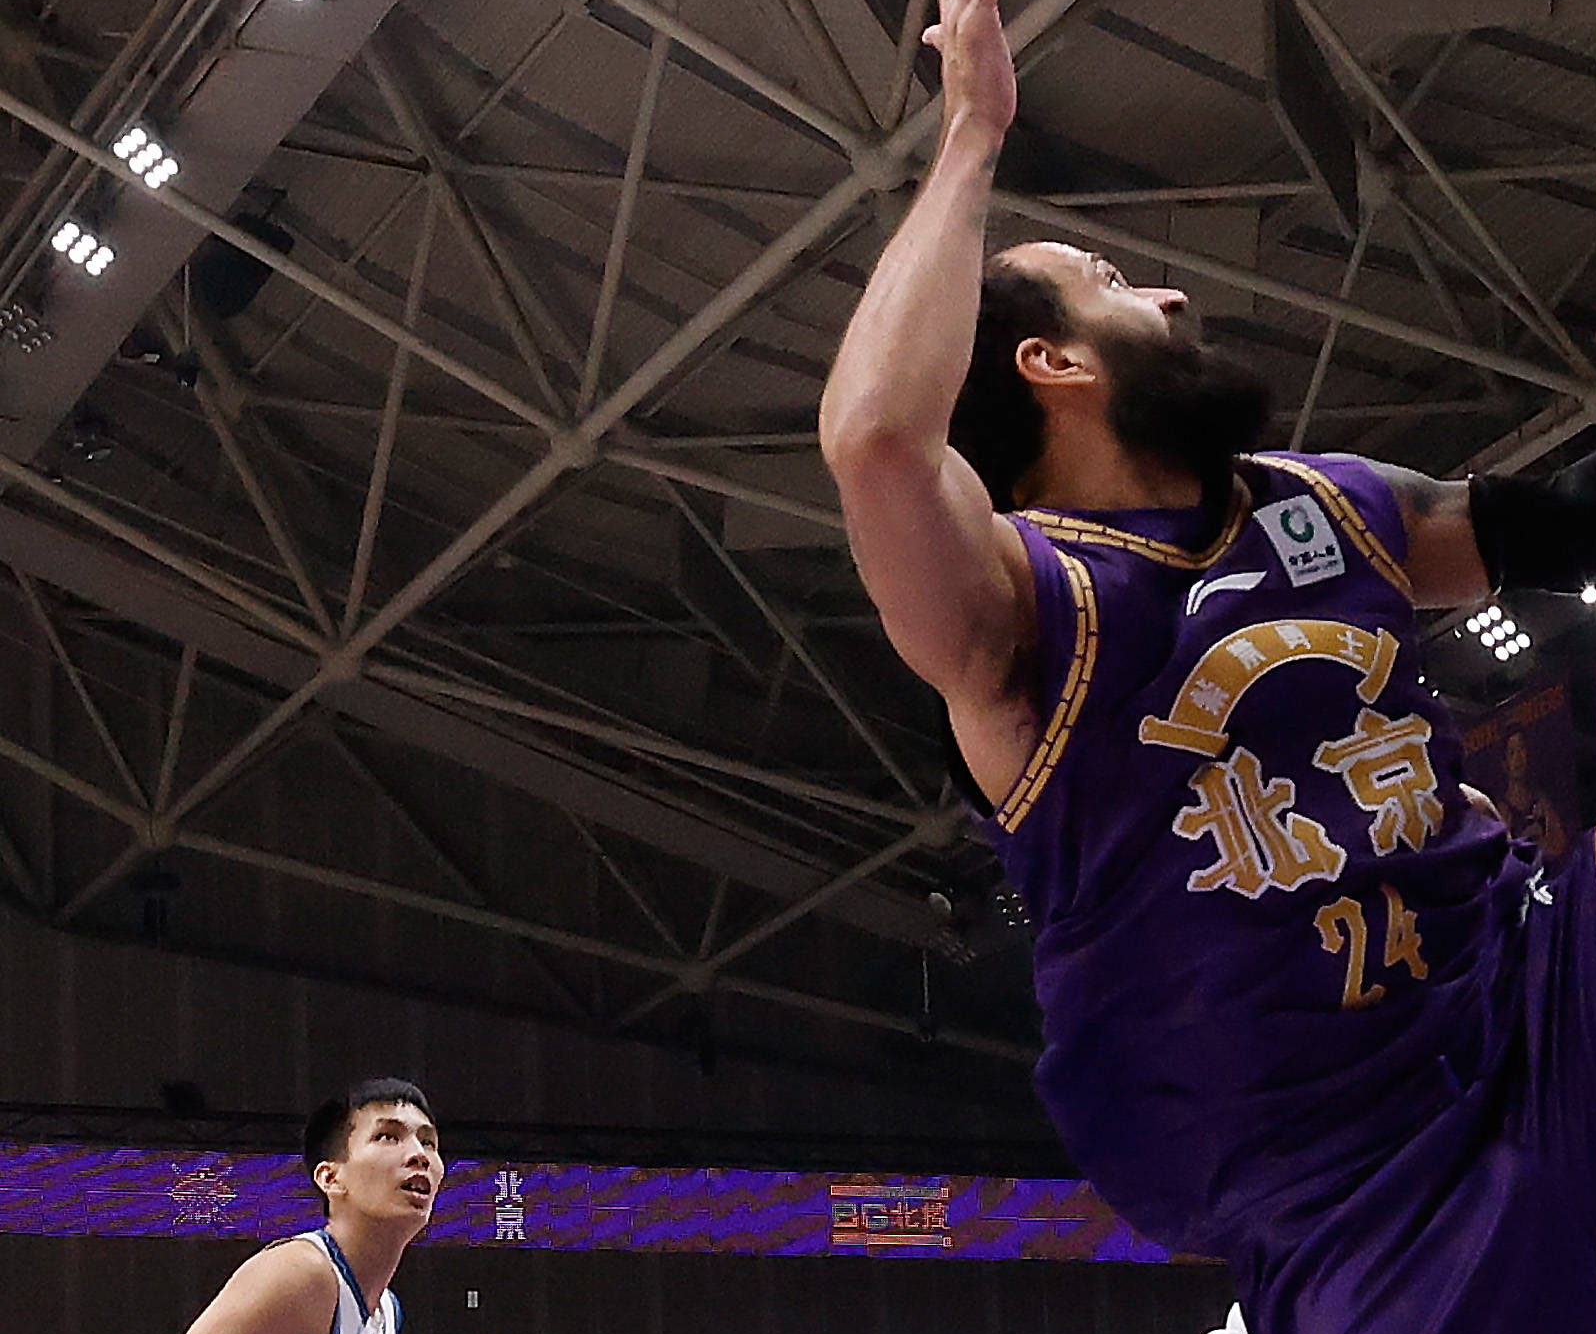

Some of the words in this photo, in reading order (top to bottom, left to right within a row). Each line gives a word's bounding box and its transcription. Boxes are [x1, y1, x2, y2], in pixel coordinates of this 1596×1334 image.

[1172, 707, 1446, 900] 北京
[1312, 883, 1429, 1010] 24
[494, 1170, 527, 1240] 北京
